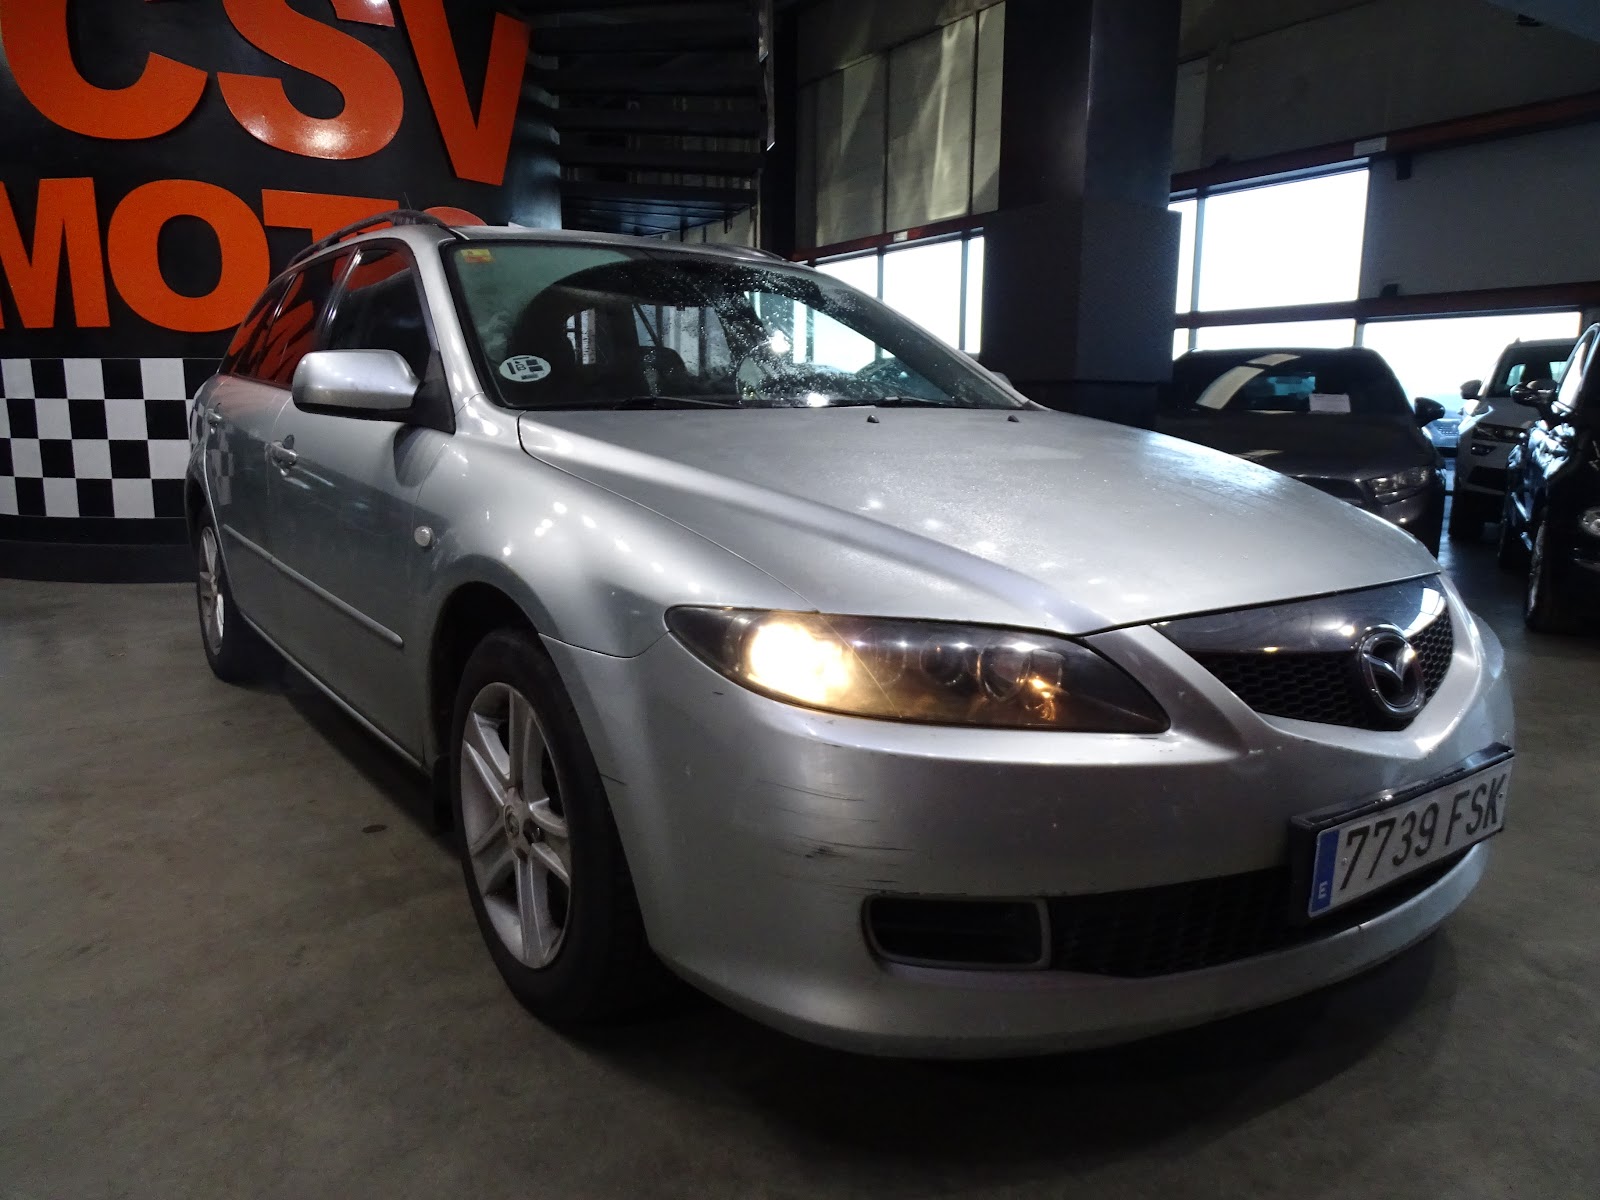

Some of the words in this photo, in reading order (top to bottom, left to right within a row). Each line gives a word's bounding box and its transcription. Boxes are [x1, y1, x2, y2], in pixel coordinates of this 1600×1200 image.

[0, 0, 530, 186] CSV
[0, 175, 488, 333] MOT
[1317, 880, 1329, 899] E
[1339, 802, 1440, 891] 7739
[1444, 773, 1507, 846] FSK
